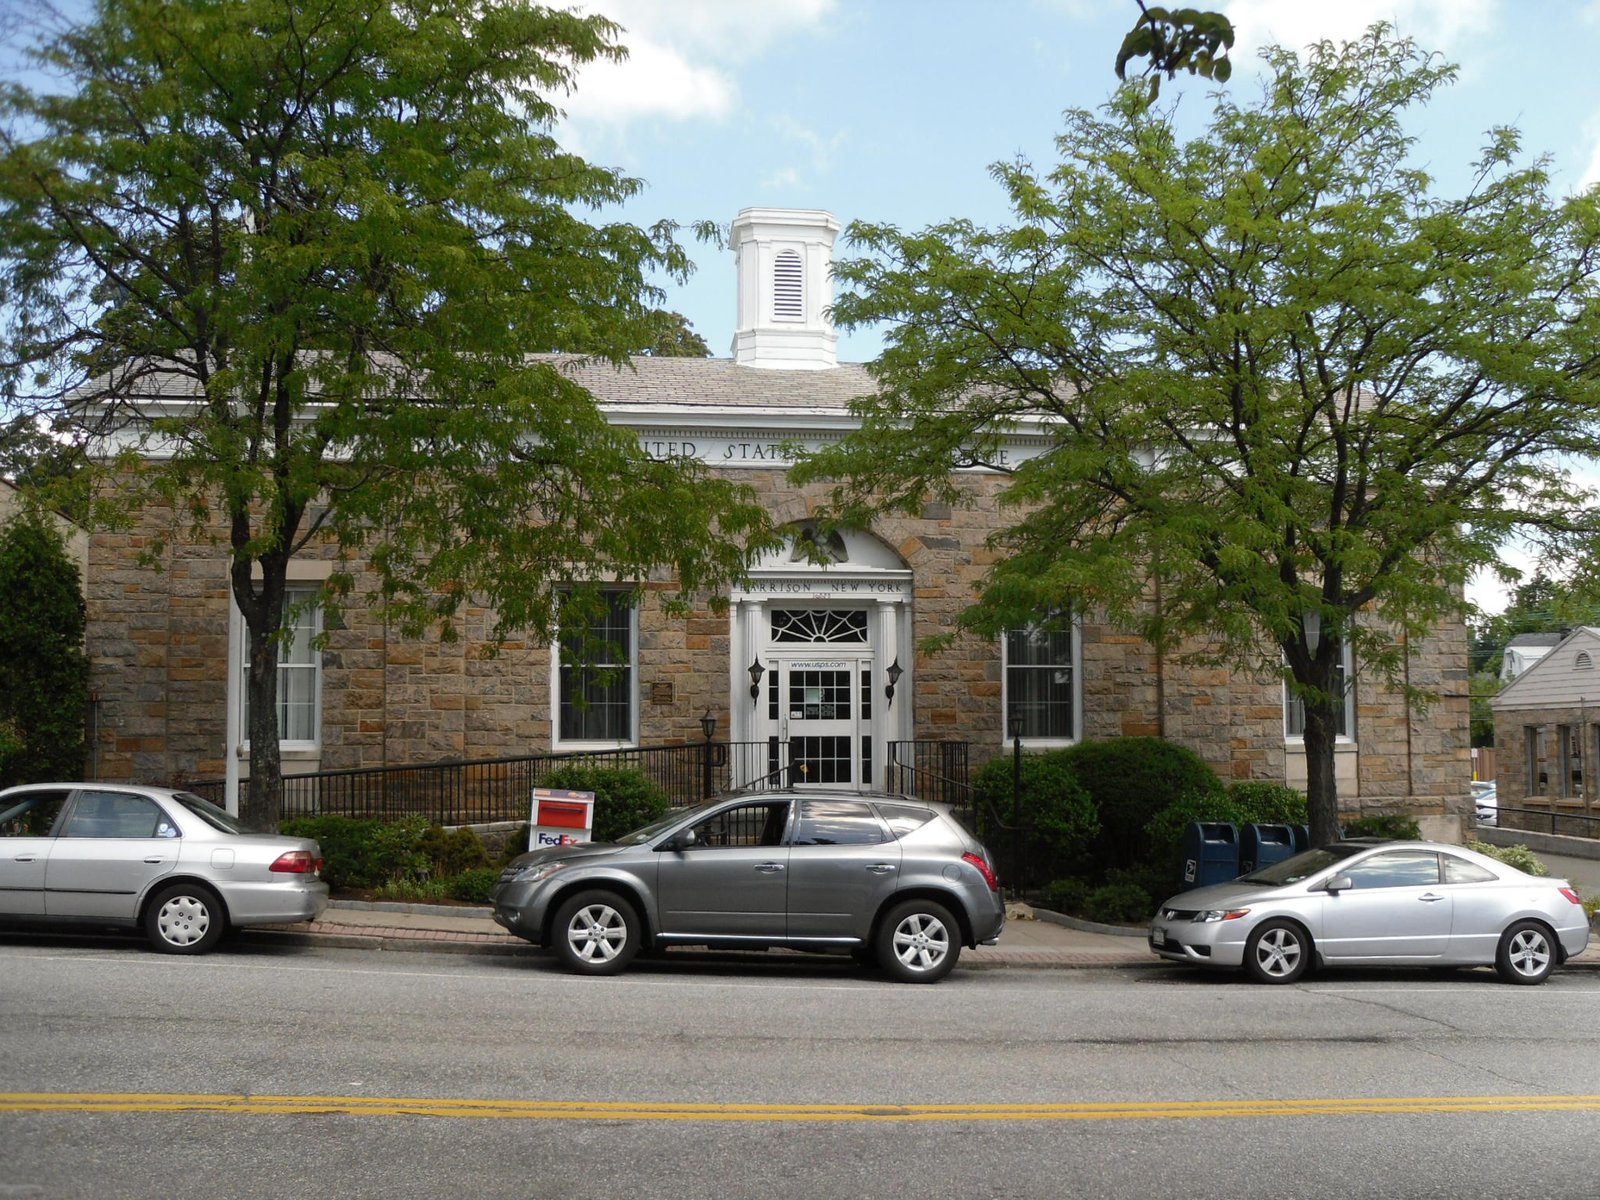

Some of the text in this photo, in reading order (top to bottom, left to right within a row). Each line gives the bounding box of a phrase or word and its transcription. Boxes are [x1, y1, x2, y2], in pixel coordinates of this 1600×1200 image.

[643, 441, 697, 458] ITED
[831, 583, 859, 592] NEW
[868, 583, 903, 593] YORK
[791, 661, 847, 669] www.usps.com
[538, 832, 578, 846] FedEx
